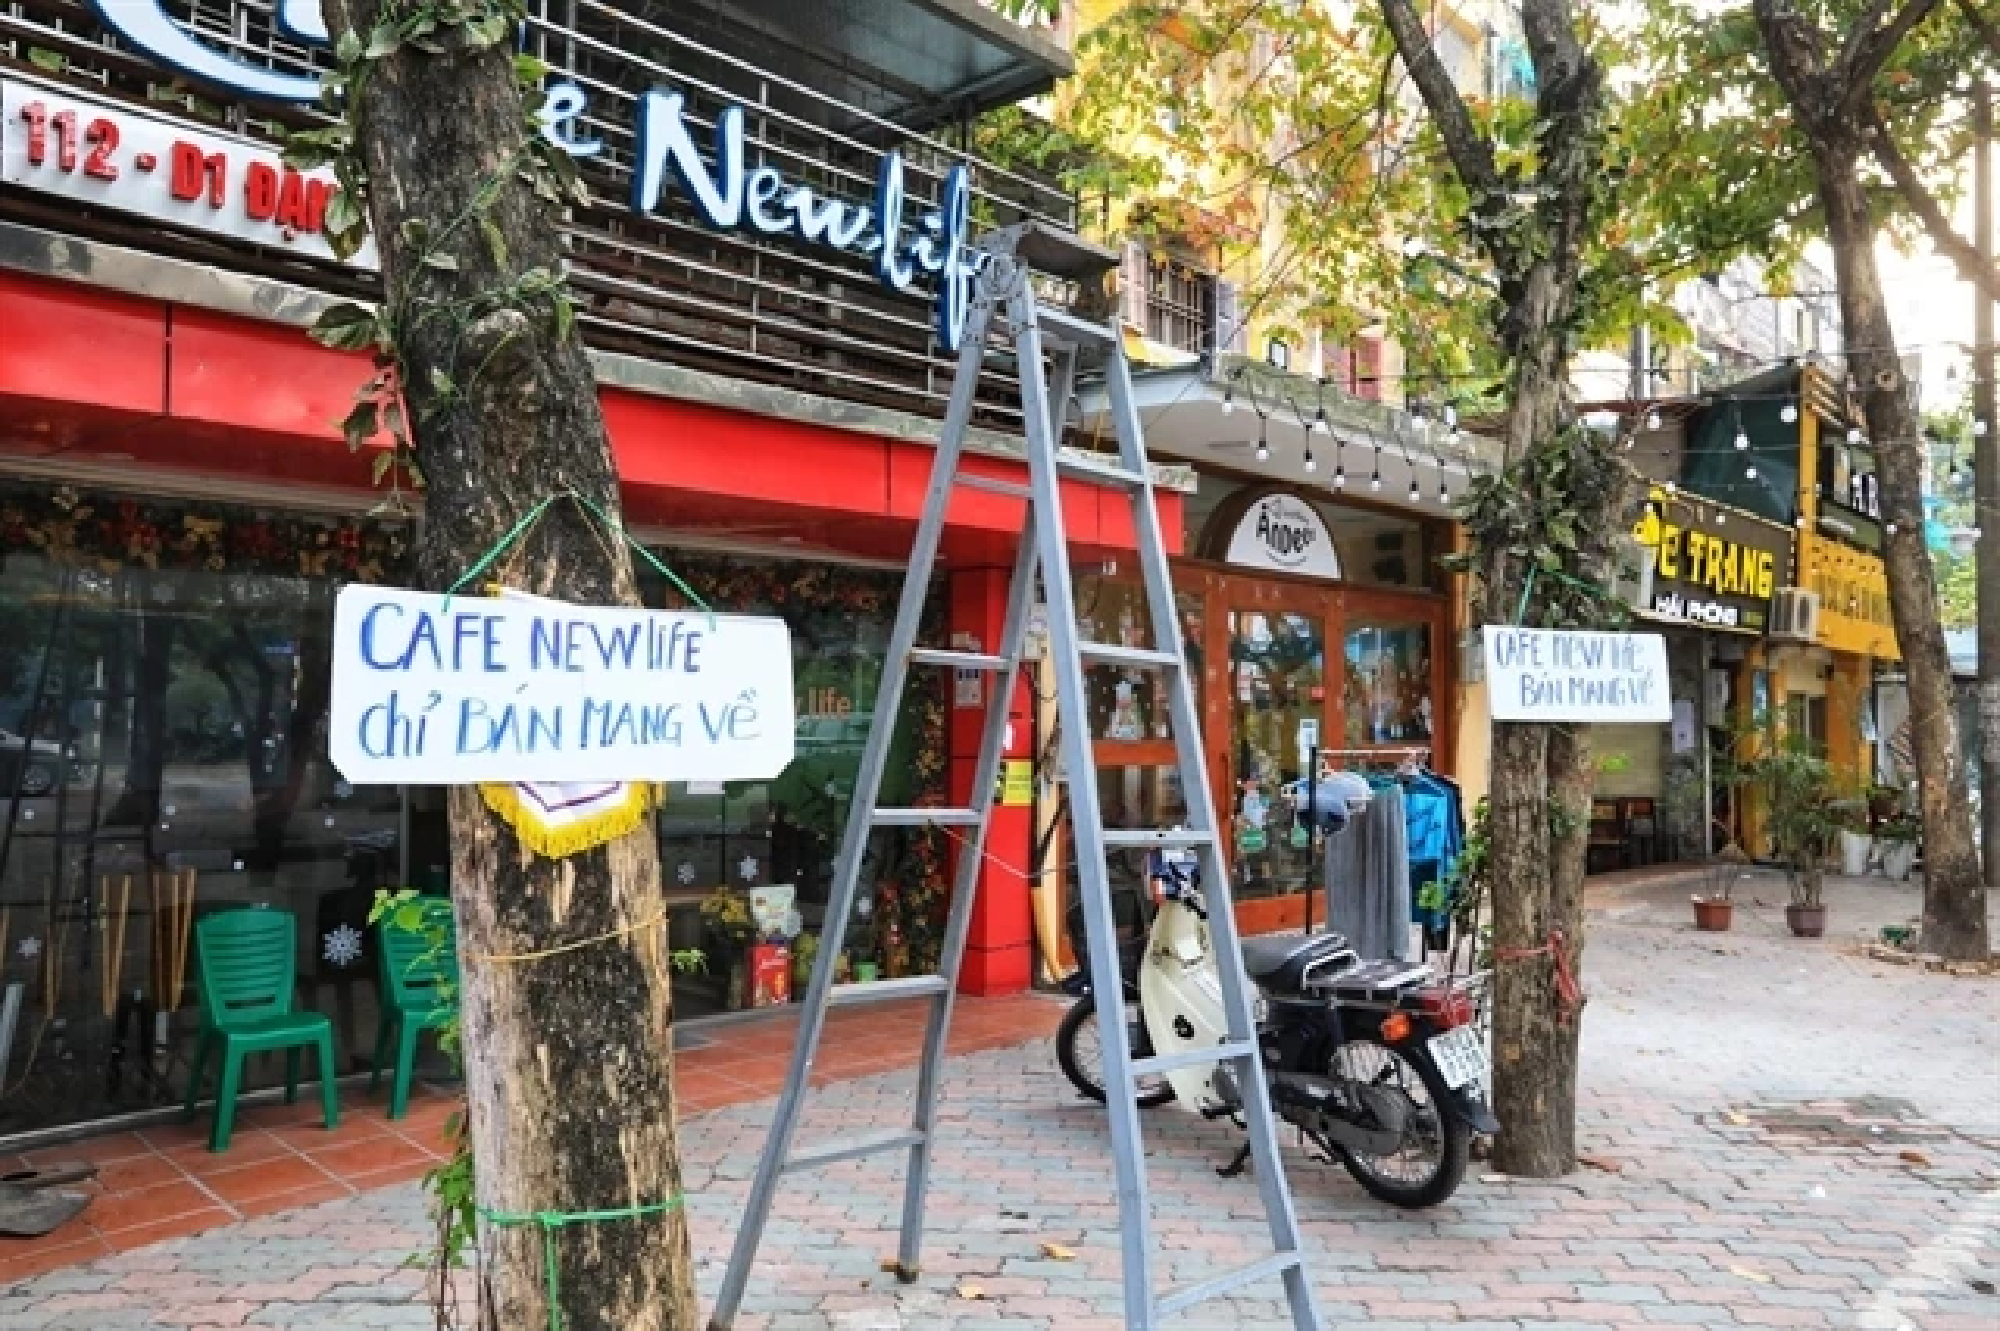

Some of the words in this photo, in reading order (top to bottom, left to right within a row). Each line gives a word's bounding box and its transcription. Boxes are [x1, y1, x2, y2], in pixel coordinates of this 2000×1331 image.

[20, 100, 120, 182] 112
[168, 138, 227, 210] D1
[636, 84, 993, 353] Newlif
[1688, 530, 1774, 598] TRANG
[359, 601, 507, 673] CAFE
[1494, 629, 1543, 669] CAFE
[455, 681, 563, 755] BÁN
[579, 696, 683, 752] MANG
[807, 686, 851, 718] life
